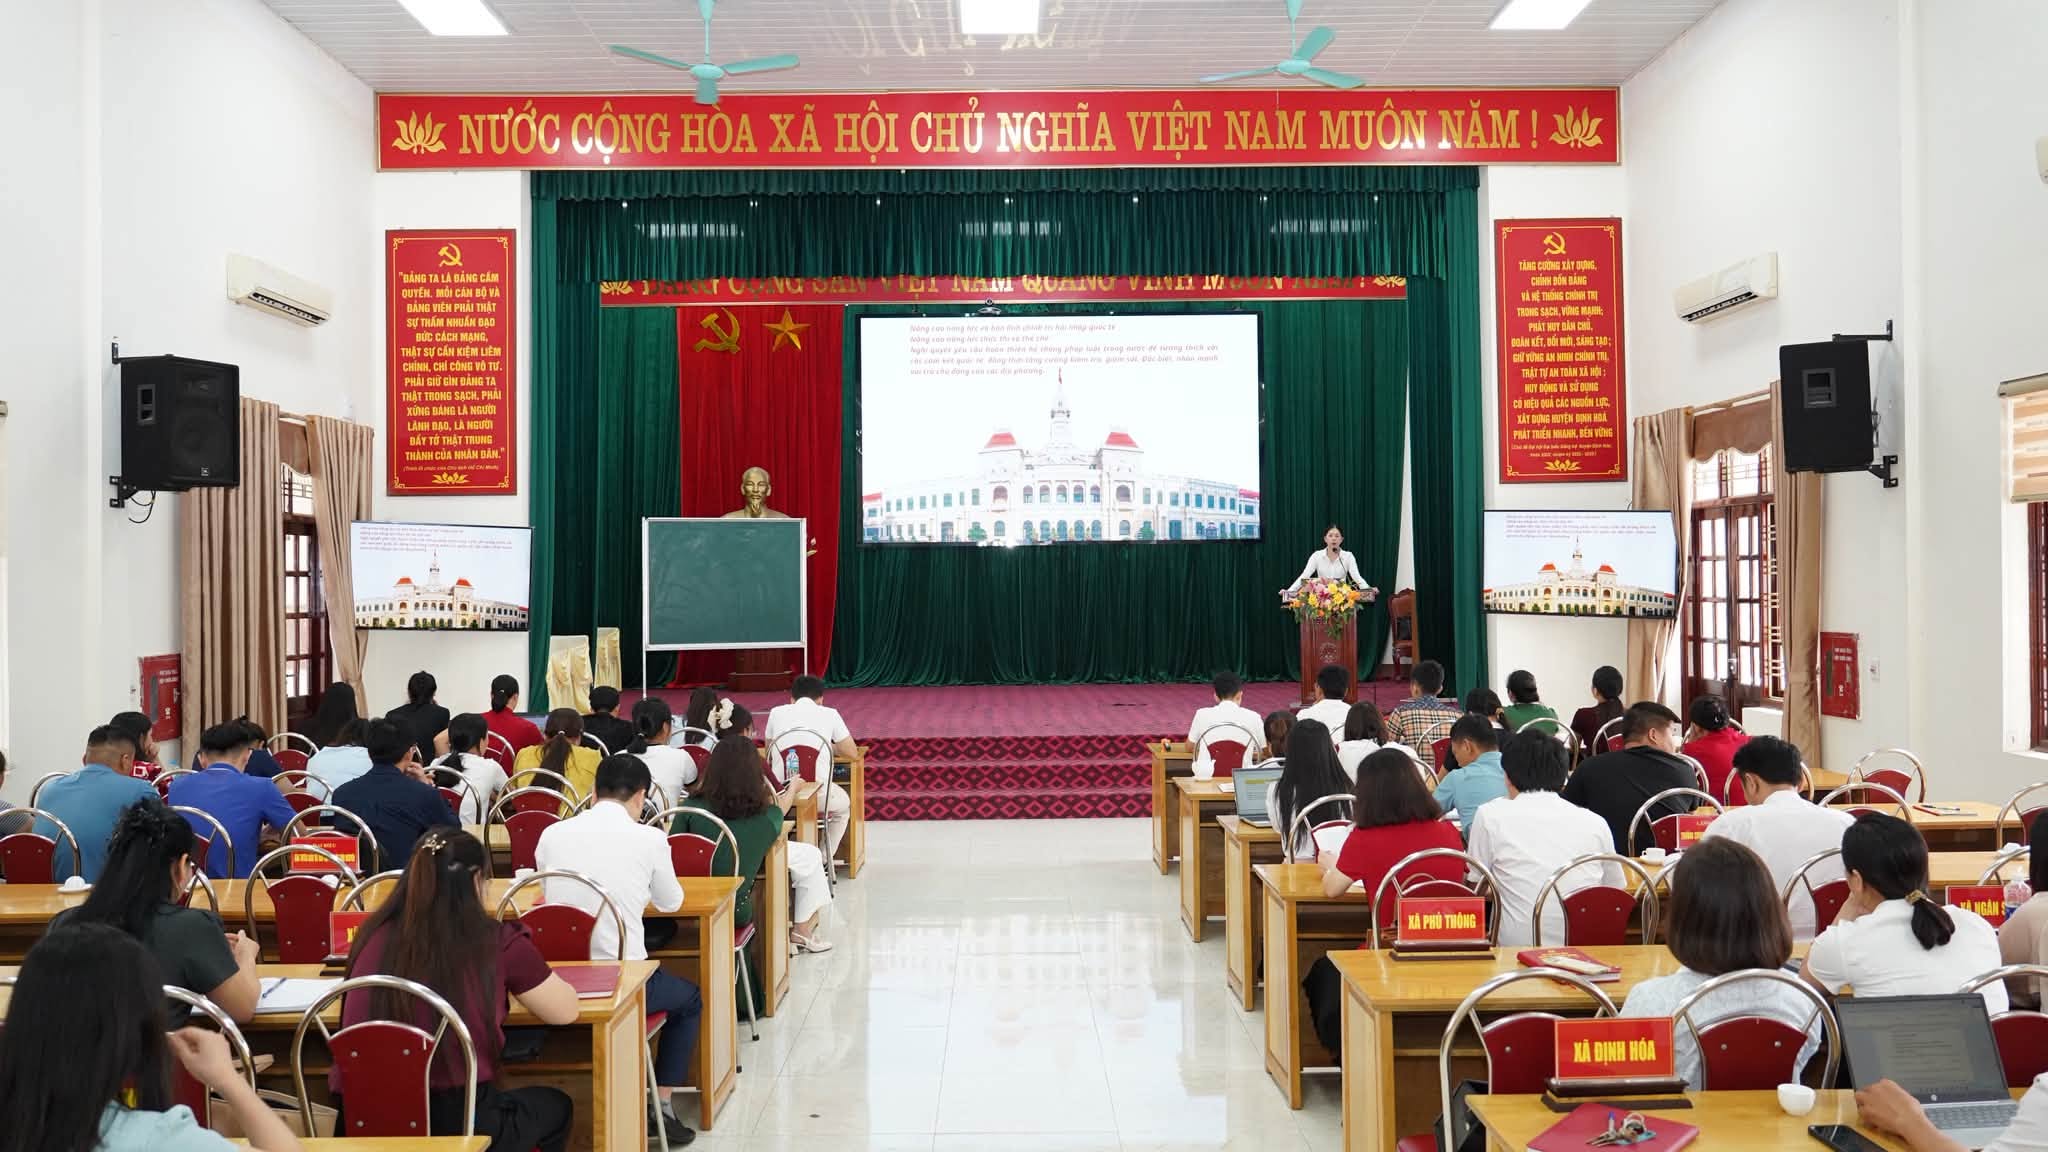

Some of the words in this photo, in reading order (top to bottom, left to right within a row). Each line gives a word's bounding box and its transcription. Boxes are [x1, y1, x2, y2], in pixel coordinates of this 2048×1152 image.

[459, 100, 560, 154] NƯỚC
[571, 101, 671, 165] CỘNG
[680, 104, 758, 153] HÒA
[769, 104, 822, 152] XÃ
[834, 100, 899, 163] HỘI
[910, 97, 985, 153] CHỦ
[997, 102, 1116, 152] NGHĨA
[1127, 100, 1211, 161] VIỆT
[1225, 110, 1307, 151] NAM
[1319, 98, 1427, 151] MUÔN
[1439, 99, 1520, 150] NĂM
[1531, 110, 1539, 149] !
[1975, 899, 1999, 916] NGÂN
[1408, 912, 1420, 929] XÃ
[1423, 911, 1442, 929] PHỦ
[1444, 912, 1476, 929] THÔNG
[1574, 1039, 1591, 1063] XÃ
[1594, 1040, 1626, 1066] ĐỊNH
[1629, 1037, 1656, 1061] HÓA
